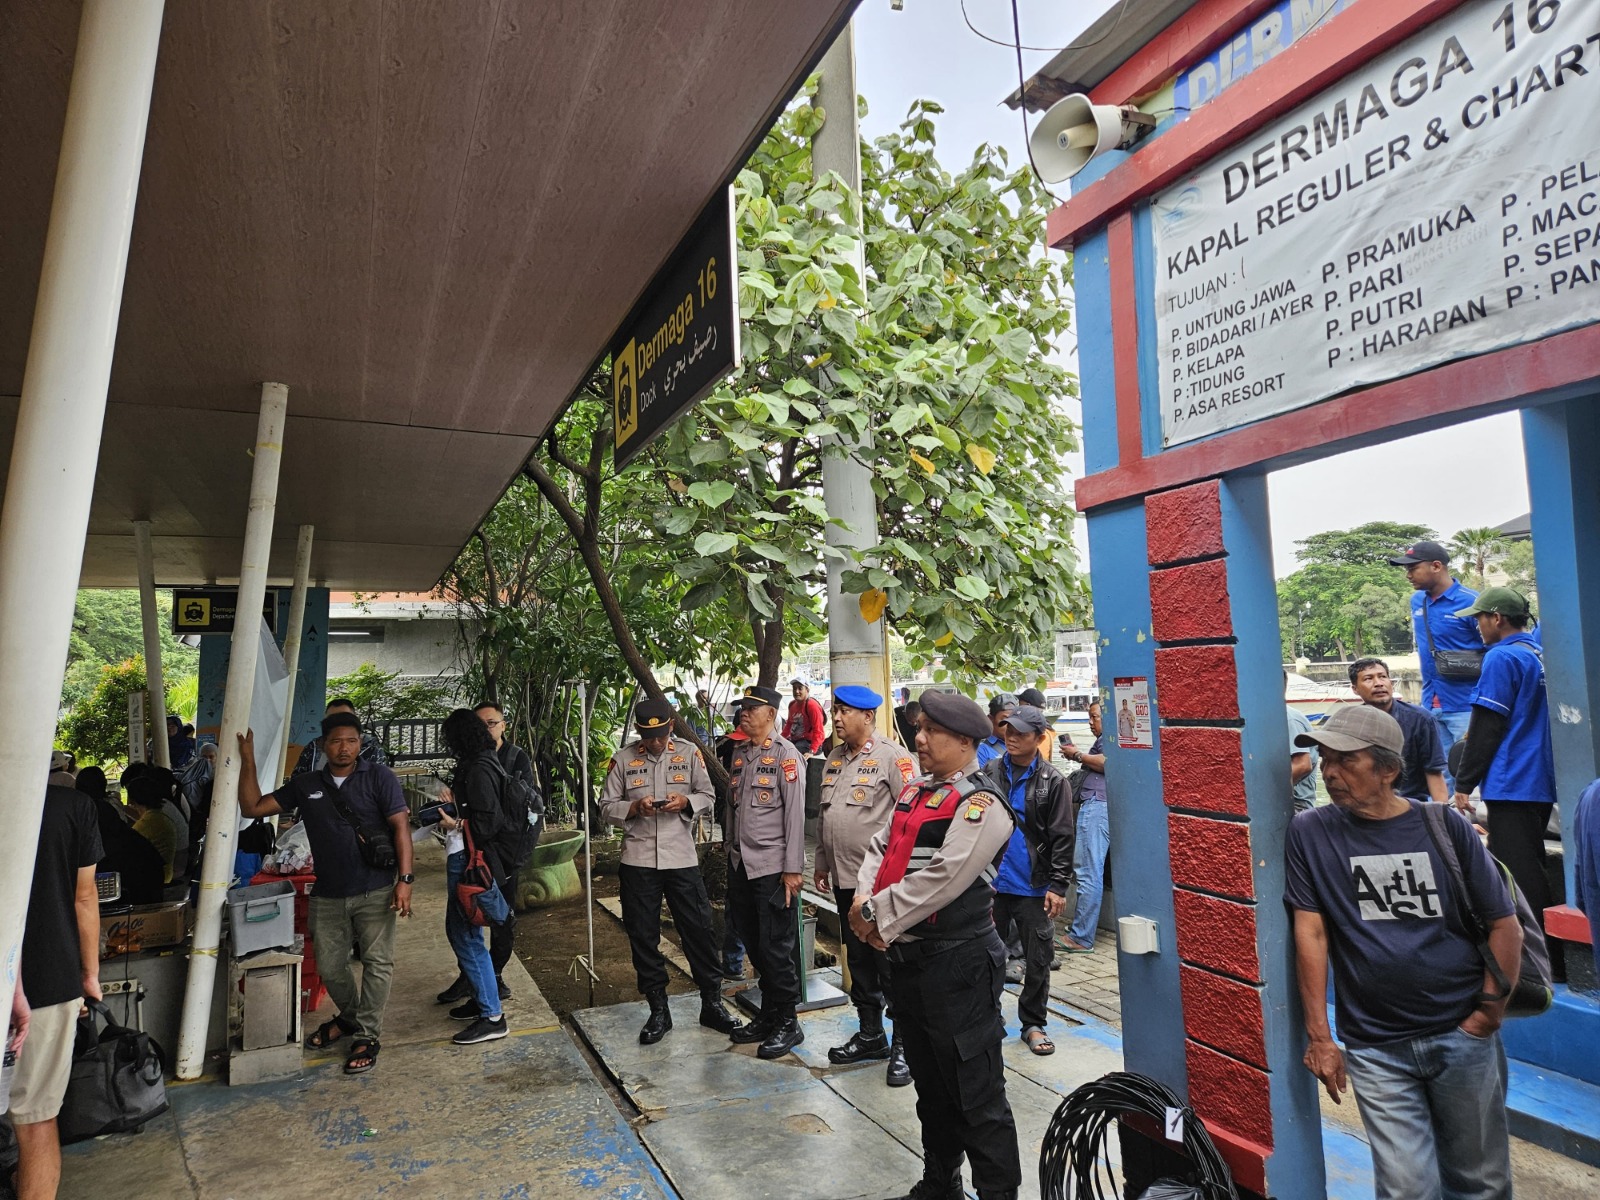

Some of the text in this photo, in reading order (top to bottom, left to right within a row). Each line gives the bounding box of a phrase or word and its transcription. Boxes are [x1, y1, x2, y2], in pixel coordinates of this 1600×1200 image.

[1187, 0, 1356, 108] DERM
[1222, 0, 1562, 205] DERMAGA 16
[1167, 222, 1249, 280] KAPAL
[1256, 134, 1412, 236] REGULER
[1423, 117, 1450, 151] &
[1541, 161, 1600, 200] PEL
[1322, 261, 1340, 284] P.
[1346, 203, 1476, 274] PRAMUKA
[1502, 191, 1600, 248] P. MAC
[1168, 272, 1227, 313] TUJUAN
[1324, 262, 1403, 312] P. PARI
[1504, 254, 1525, 278] P.
[637, 256, 717, 380] Dermaga 16
[1171, 279, 1296, 343] P. UNTUNG JAWA
[1172, 349, 1183, 363] P.
[1186, 316, 1256, 357] BIDADARI
[1269, 293, 1314, 326] AYER
[1326, 287, 1423, 340] P. PUTRI
[1362, 295, 1488, 357] HARAPAN
[1173, 345, 1245, 383] P. KELAPA
[640, 381, 657, 413] Dock
[1174, 373, 1286, 423] P. ASA RESORT
